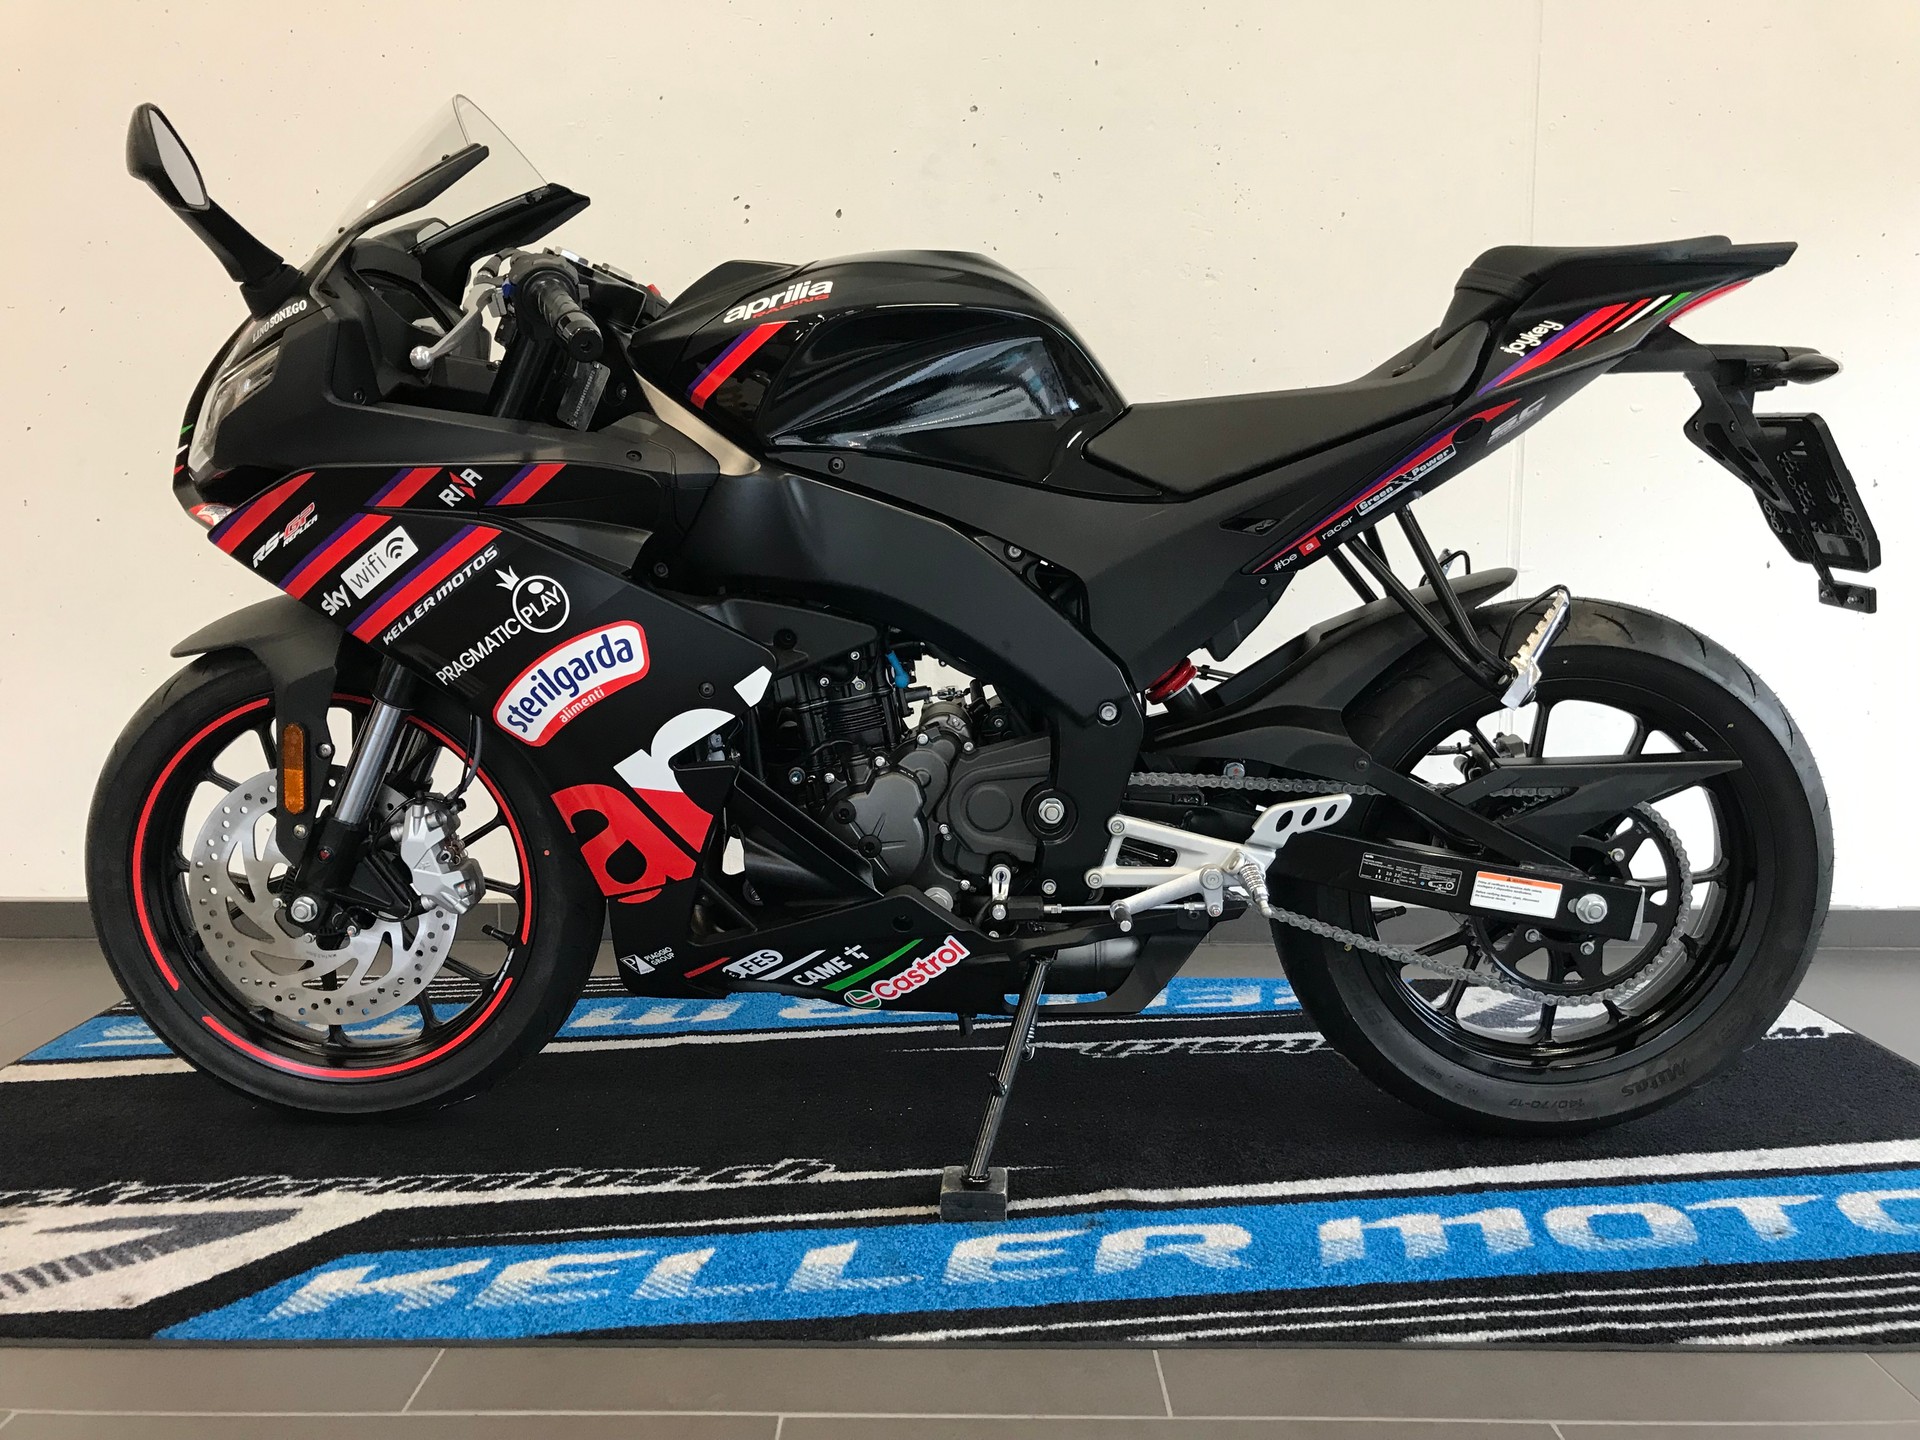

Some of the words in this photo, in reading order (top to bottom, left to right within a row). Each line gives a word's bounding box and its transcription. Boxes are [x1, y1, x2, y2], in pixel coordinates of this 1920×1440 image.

[269, 299, 308, 329] SONEGO
[723, 280, 833, 323] aprilia
[1500, 319, 1564, 356] joykey
[438, 468, 483, 507] RINA
[1359, 485, 1394, 511] Green
[1411, 448, 1450, 476] Power
[1273, 552, 1298, 571] #be
[1321, 515, 1354, 541] racer
[321, 584, 351, 617] sky
[350, 552, 387, 590] wifi
[382, 596, 436, 645] KELLER
[436, 545, 498, 601] MOTOS
[436, 618, 523, 687] PRAGMATIC
[520, 585, 562, 624] PLAY
[507, 633, 634, 734] sterilgarda
[558, 686, 605, 725] alimenti
[792, 956, 852, 986] CAME
[874, 937, 966, 999] Castrol
[262, 1222, 1252, 1322] KELLER
